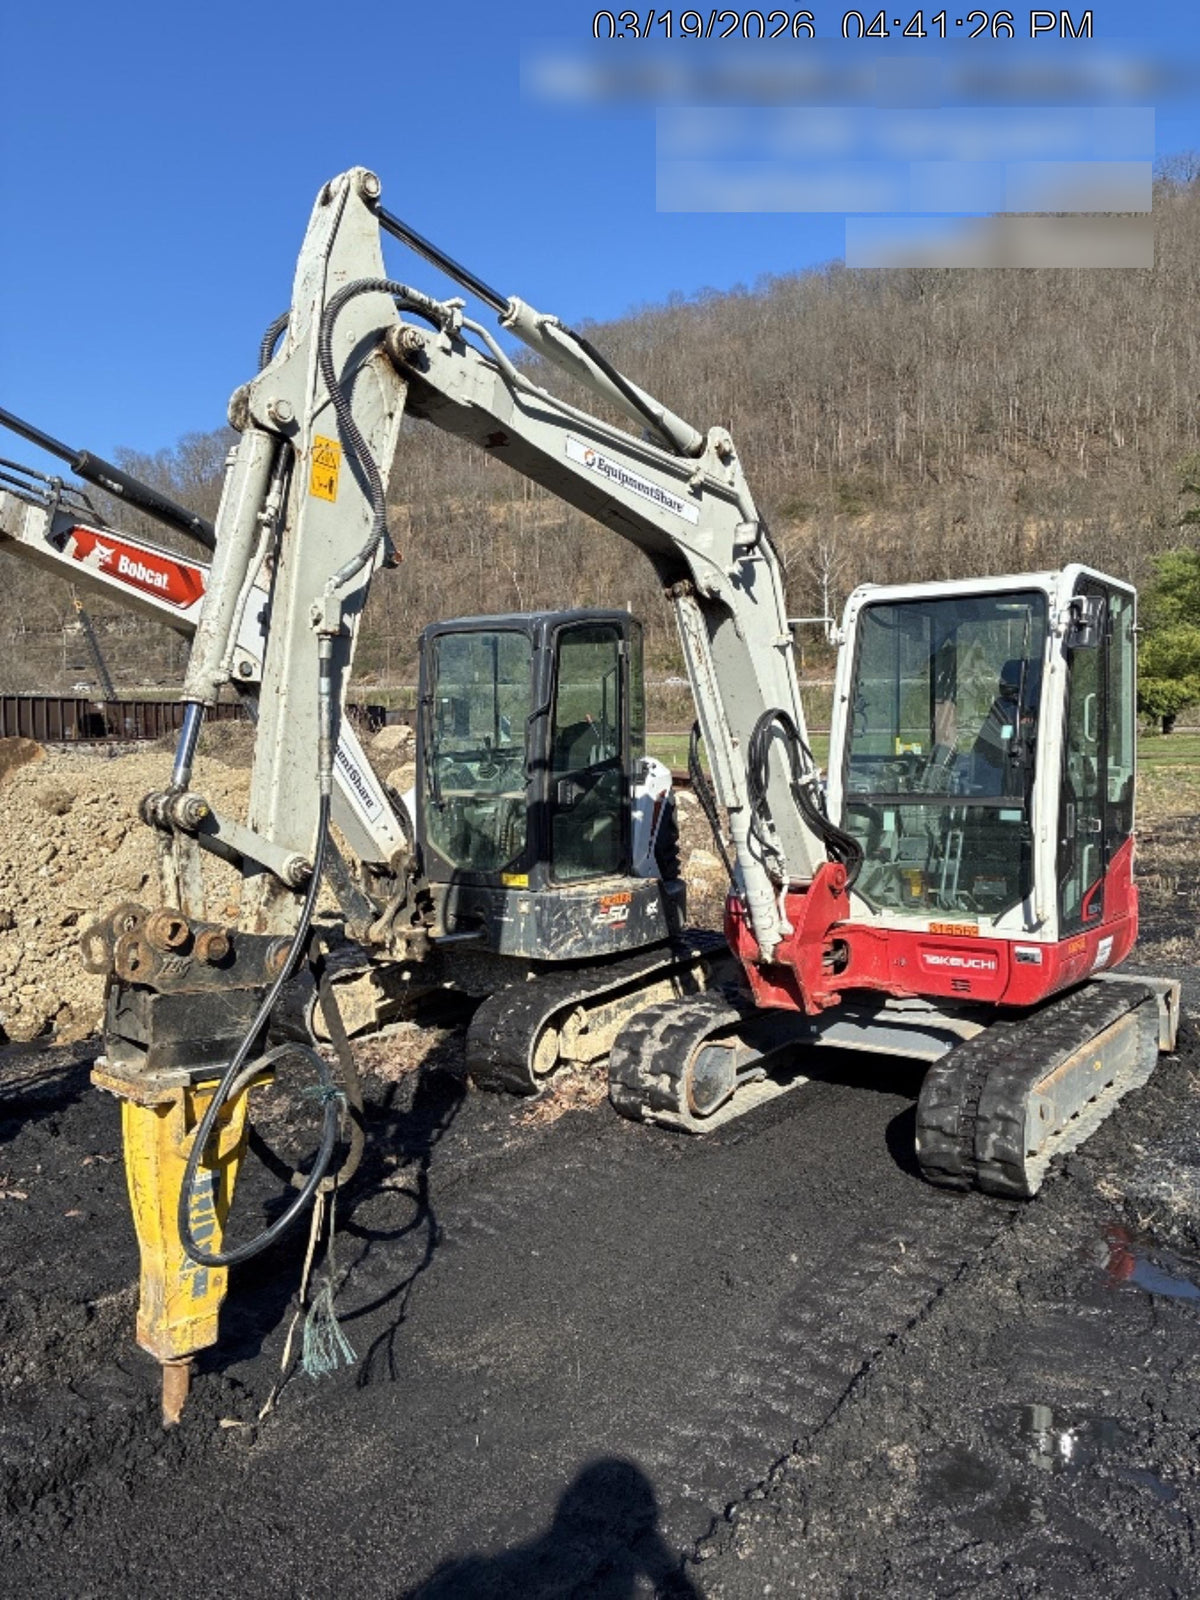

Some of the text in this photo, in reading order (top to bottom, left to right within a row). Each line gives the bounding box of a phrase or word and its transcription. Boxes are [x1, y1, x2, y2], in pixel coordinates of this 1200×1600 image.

[598, 457, 684, 513] EquipmentShare
[117, 554, 168, 590] Bobcat
[922, 954, 996, 970] TAKEUCHI
